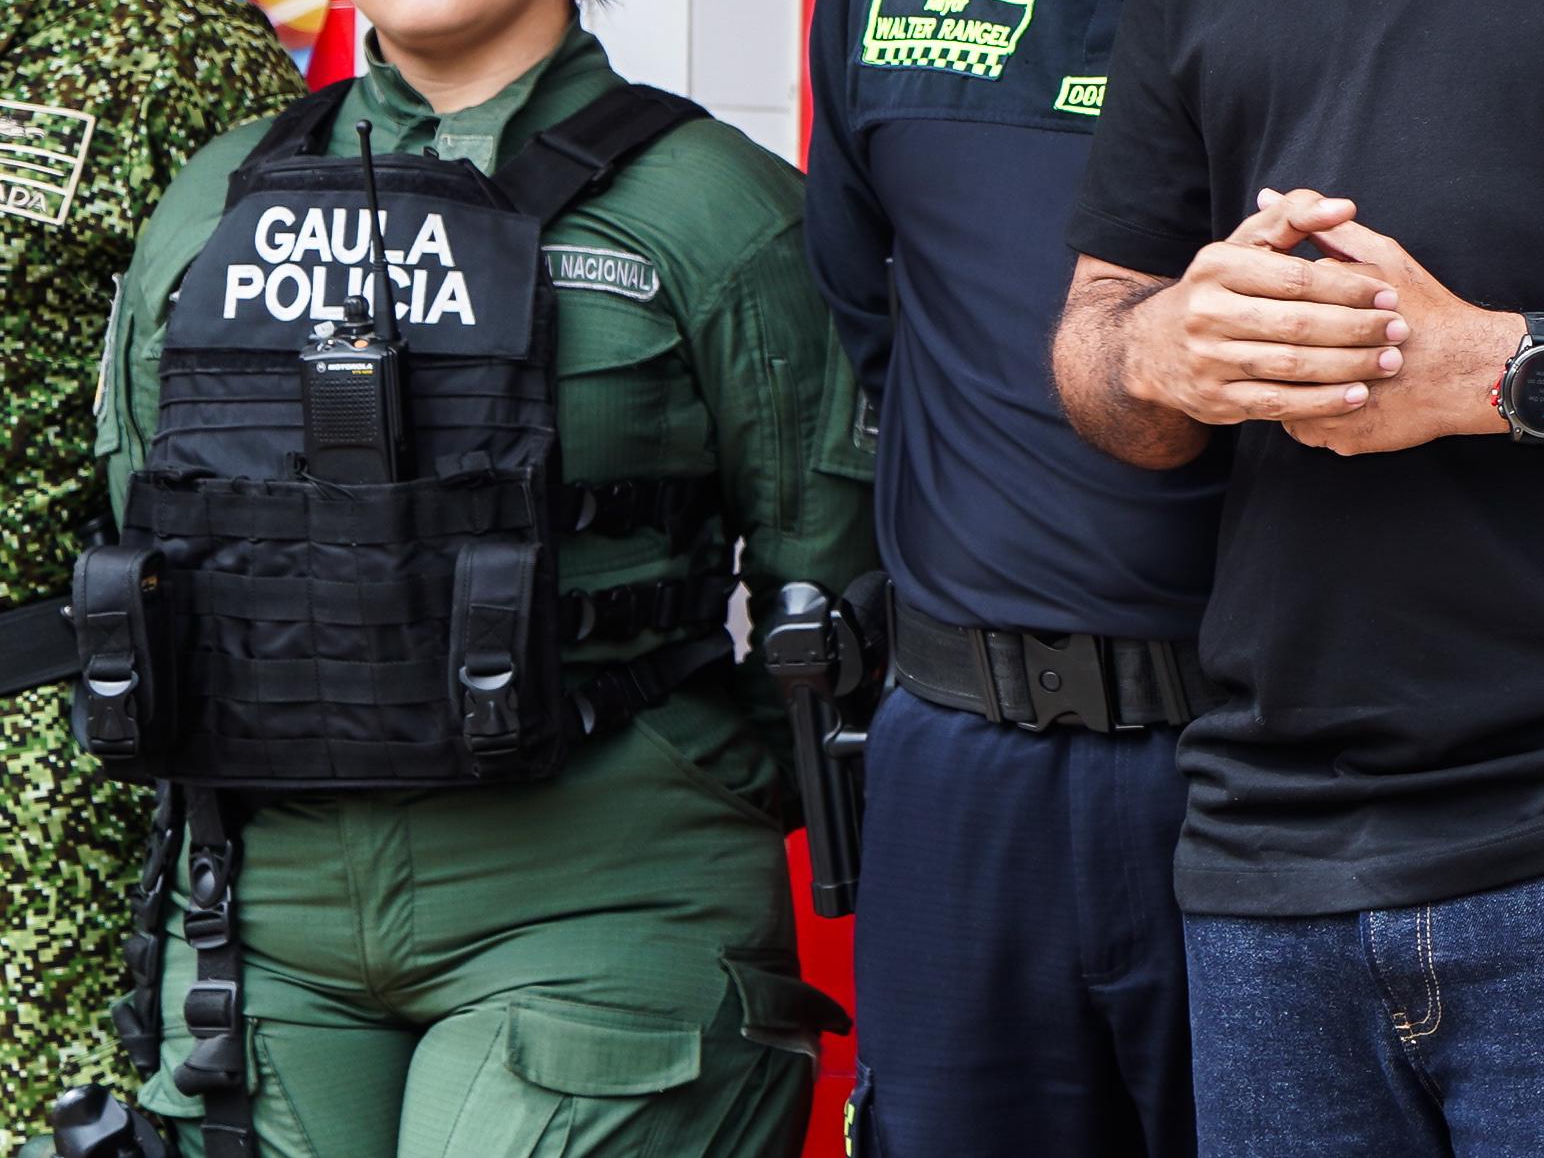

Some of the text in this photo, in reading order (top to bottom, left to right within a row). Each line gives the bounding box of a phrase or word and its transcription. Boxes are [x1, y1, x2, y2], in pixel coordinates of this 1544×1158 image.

[876, 16, 1013, 47] WALTER RANGEL
[254, 205, 457, 266] GAULA
[222, 263, 477, 326] POLICIA
[560, 254, 652, 292] NACIONAL
